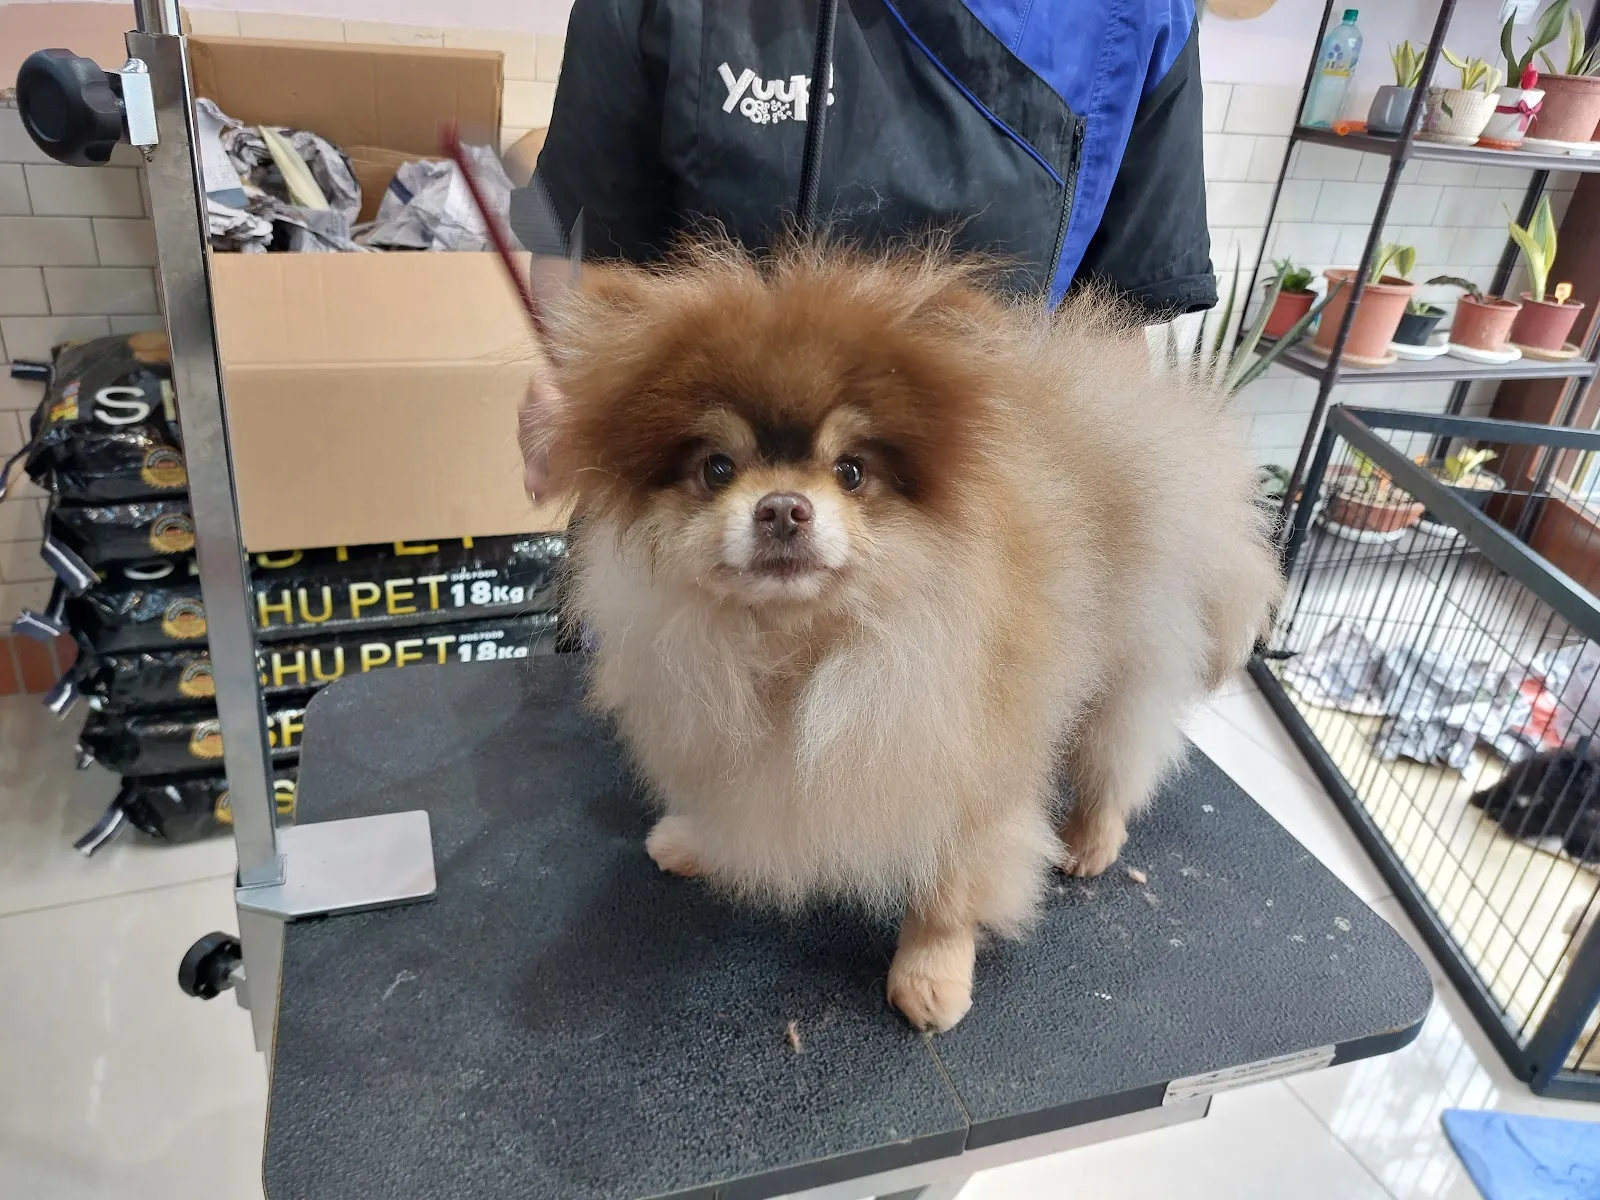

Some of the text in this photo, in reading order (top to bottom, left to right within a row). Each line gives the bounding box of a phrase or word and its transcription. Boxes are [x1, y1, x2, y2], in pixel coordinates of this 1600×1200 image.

[256, 585, 333, 629] HU
[348, 573, 448, 619] PET
[450, 580, 525, 608] 18Kg
[259, 645, 345, 687] HU
